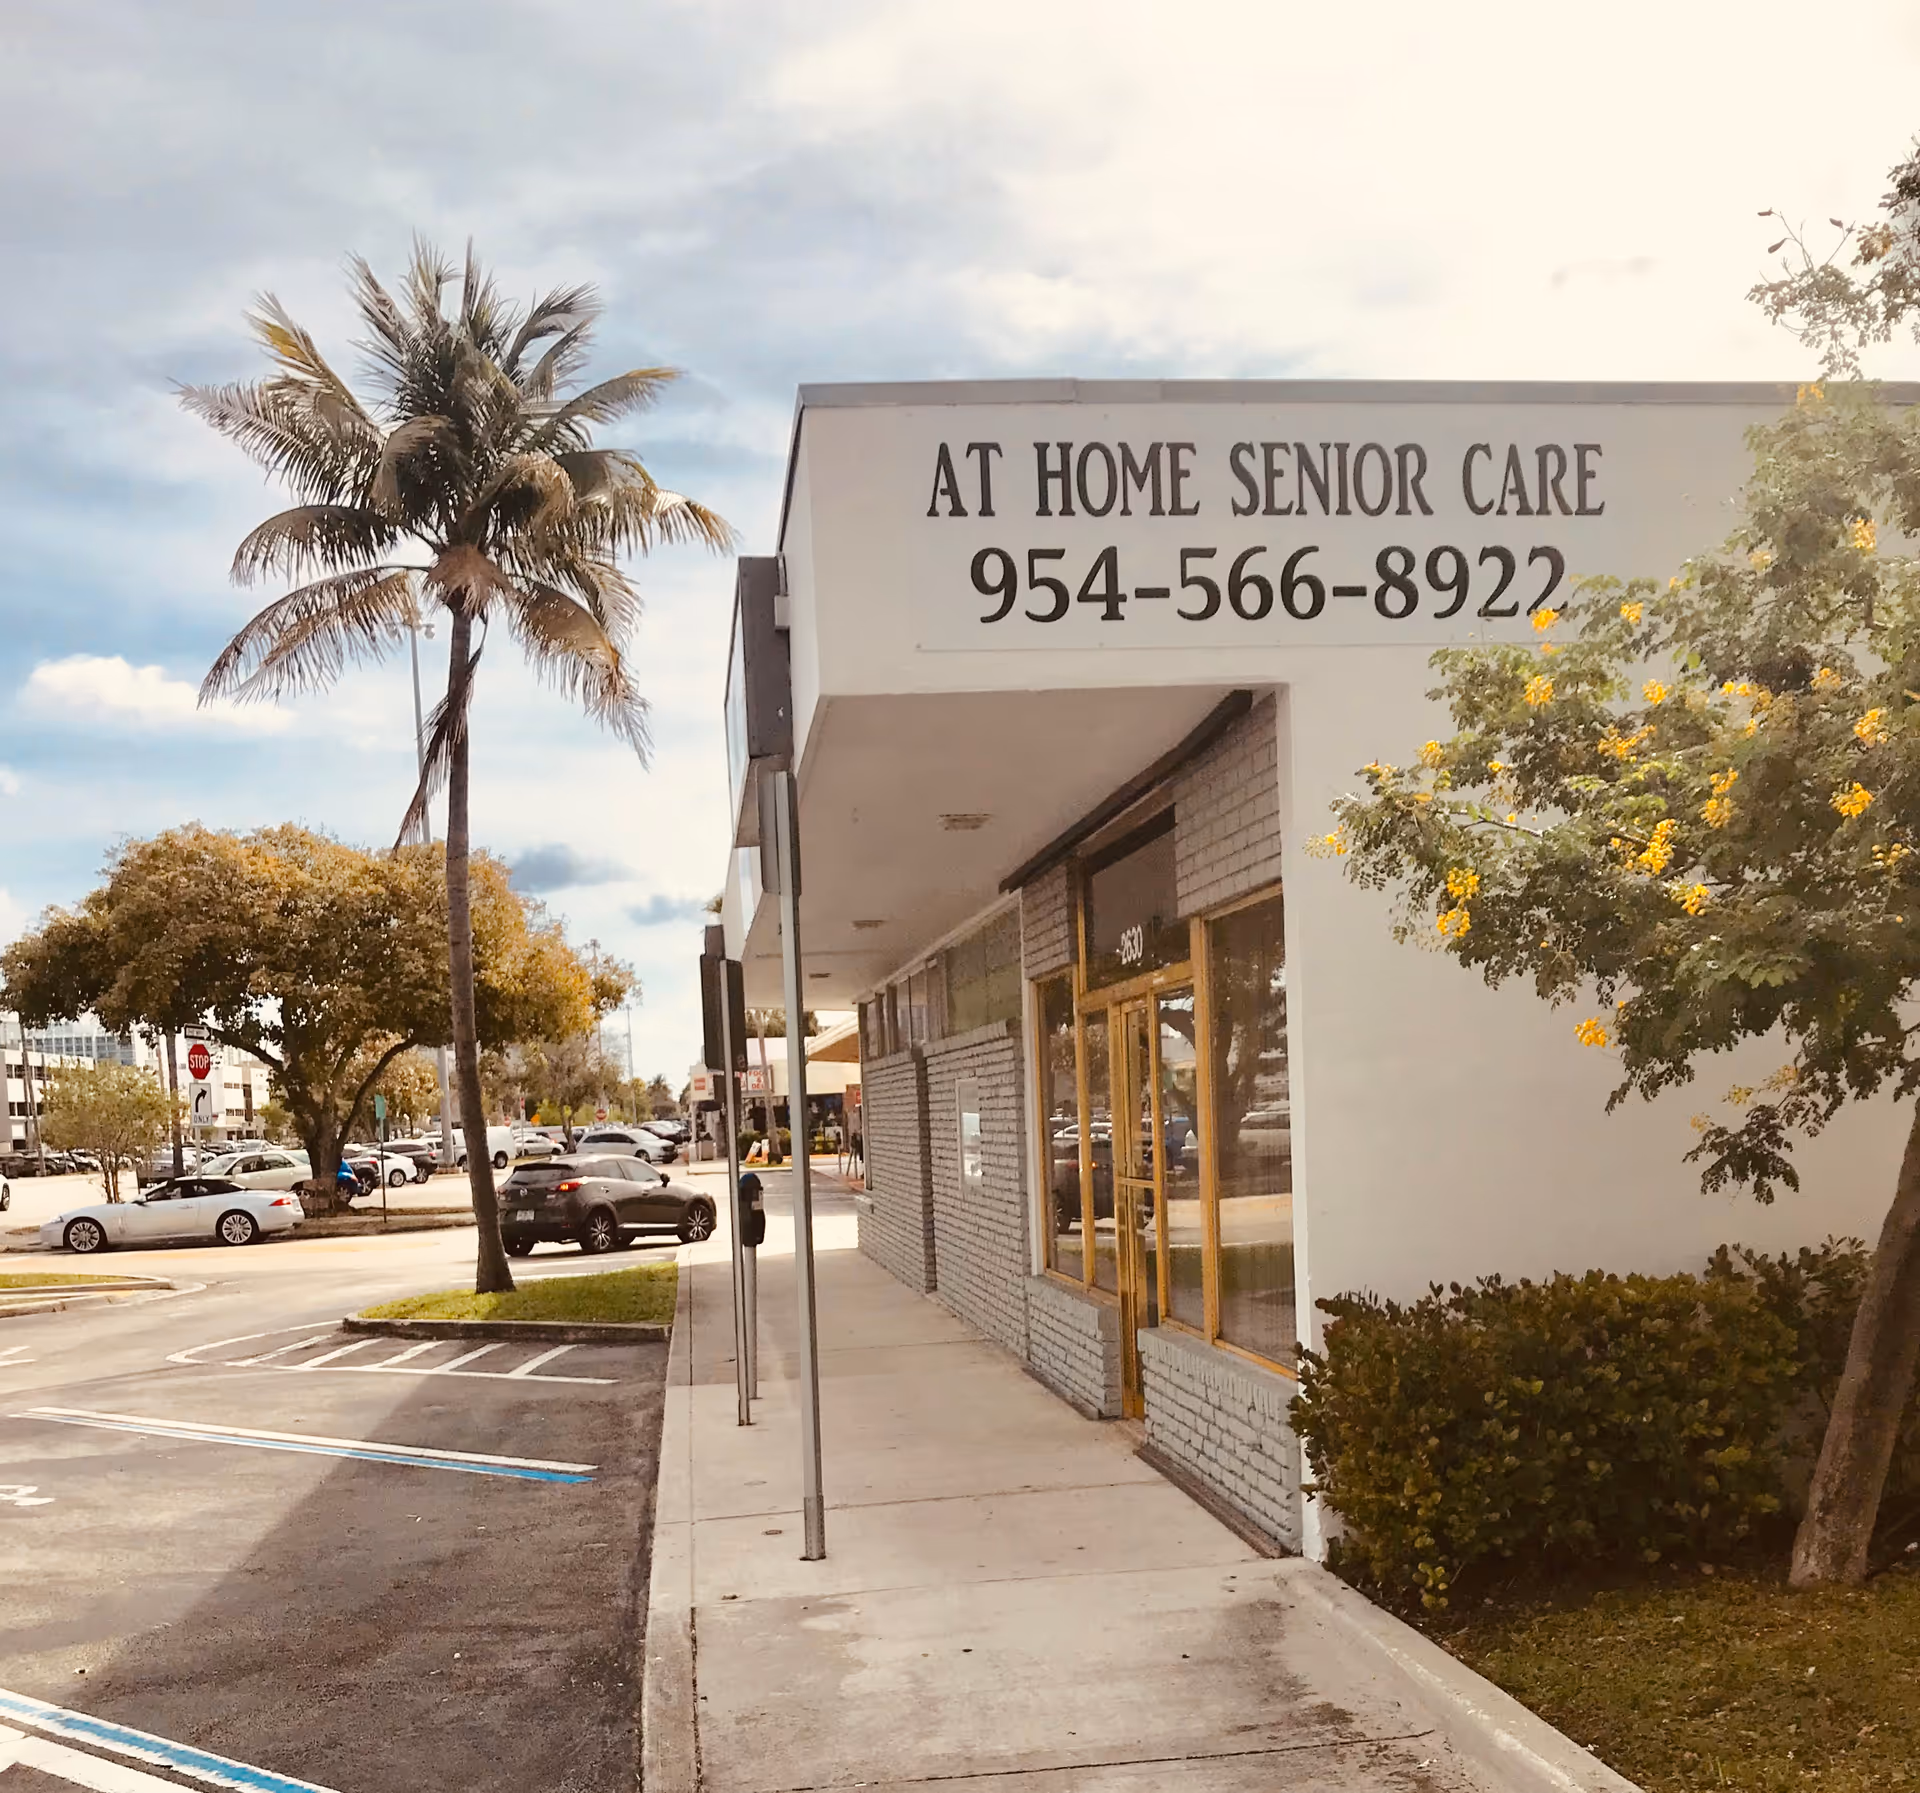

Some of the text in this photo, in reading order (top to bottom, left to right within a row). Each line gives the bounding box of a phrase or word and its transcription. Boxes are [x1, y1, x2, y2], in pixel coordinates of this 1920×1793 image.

[927, 442, 1606, 517] AT HOME SENIOR CARE
[970, 545, 1569, 624] 954-566-8922
[1120, 924, 1143, 965] 2630
[190, 1054, 209, 1070] STOP
[193, 1115, 209, 1124] ONLY
